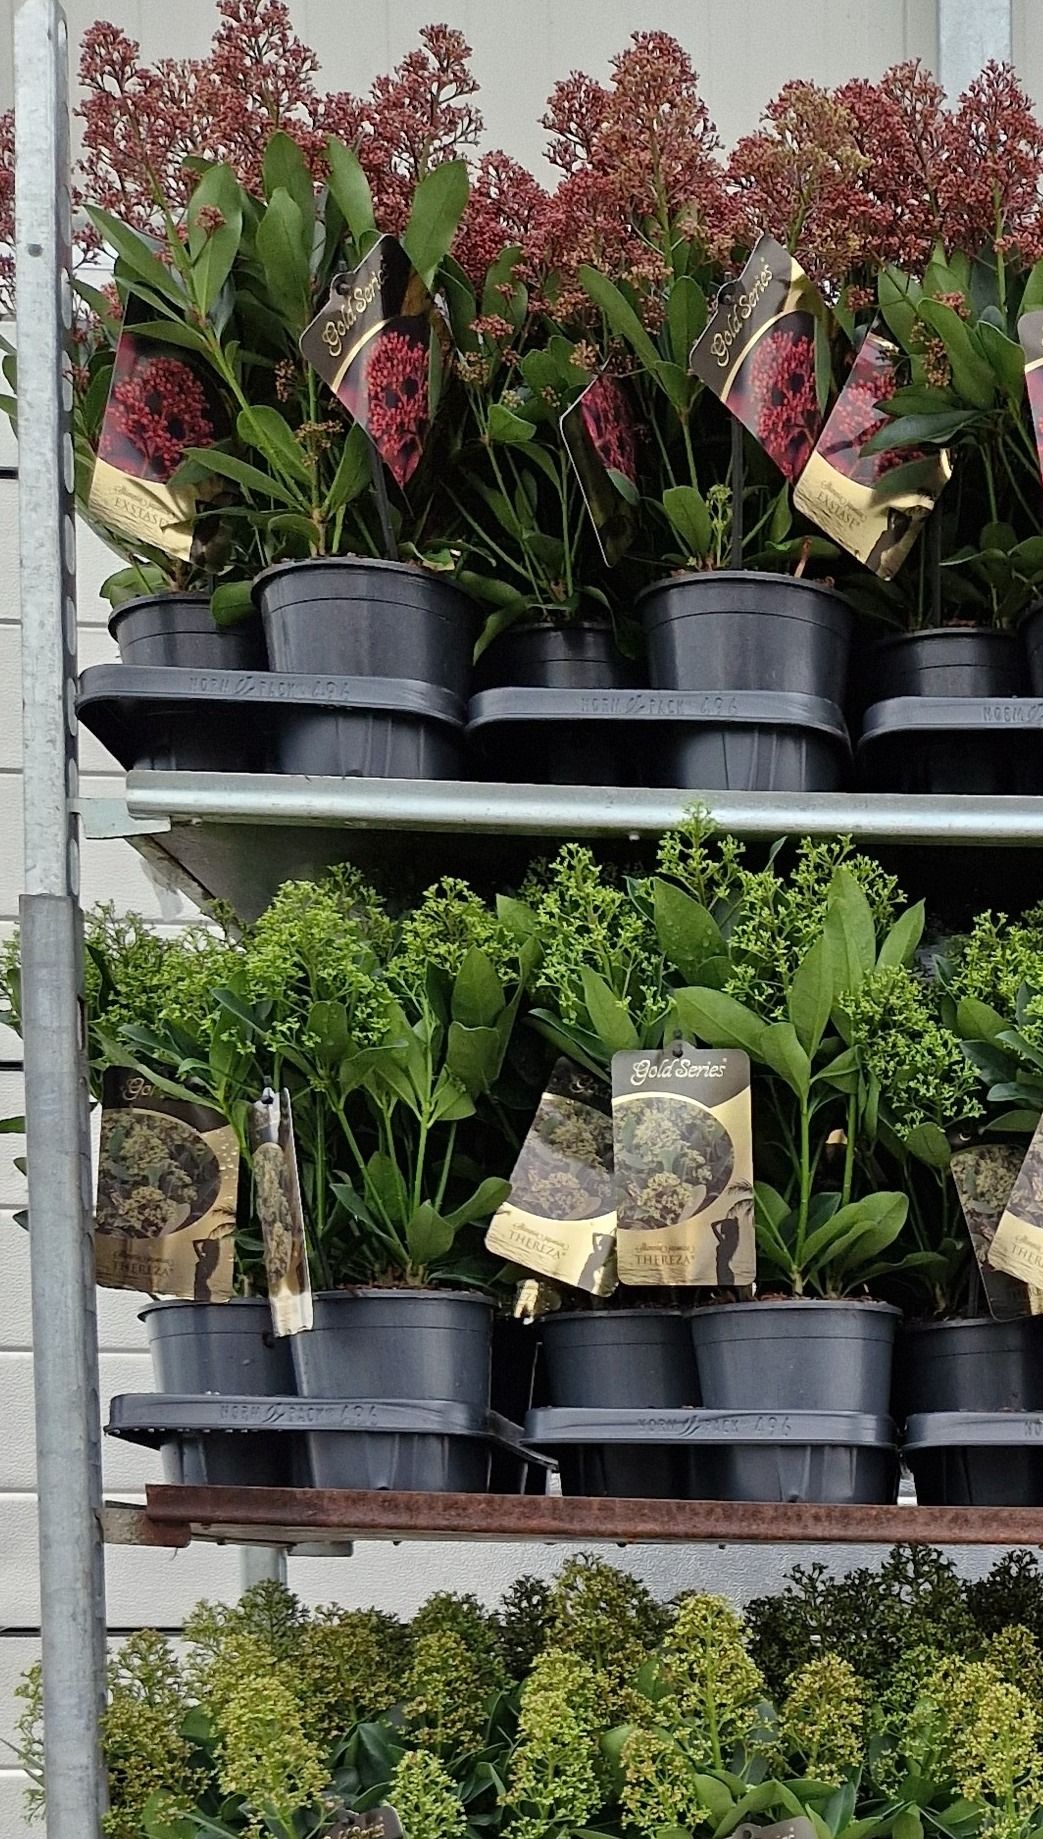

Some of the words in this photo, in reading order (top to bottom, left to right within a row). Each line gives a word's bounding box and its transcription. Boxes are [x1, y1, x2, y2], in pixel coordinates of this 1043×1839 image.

[322, 296, 357, 357] Gold
[711, 311, 744, 367] Gold
[739, 263, 774, 319] Series
[816, 491, 857, 528] EXSTASE
[631, 1059, 673, 1085] Gold
[673, 1060, 726, 1078] Series
[508, 1230, 561, 1259] THEREZA
[635, 1254, 692, 1265] THEREZA
